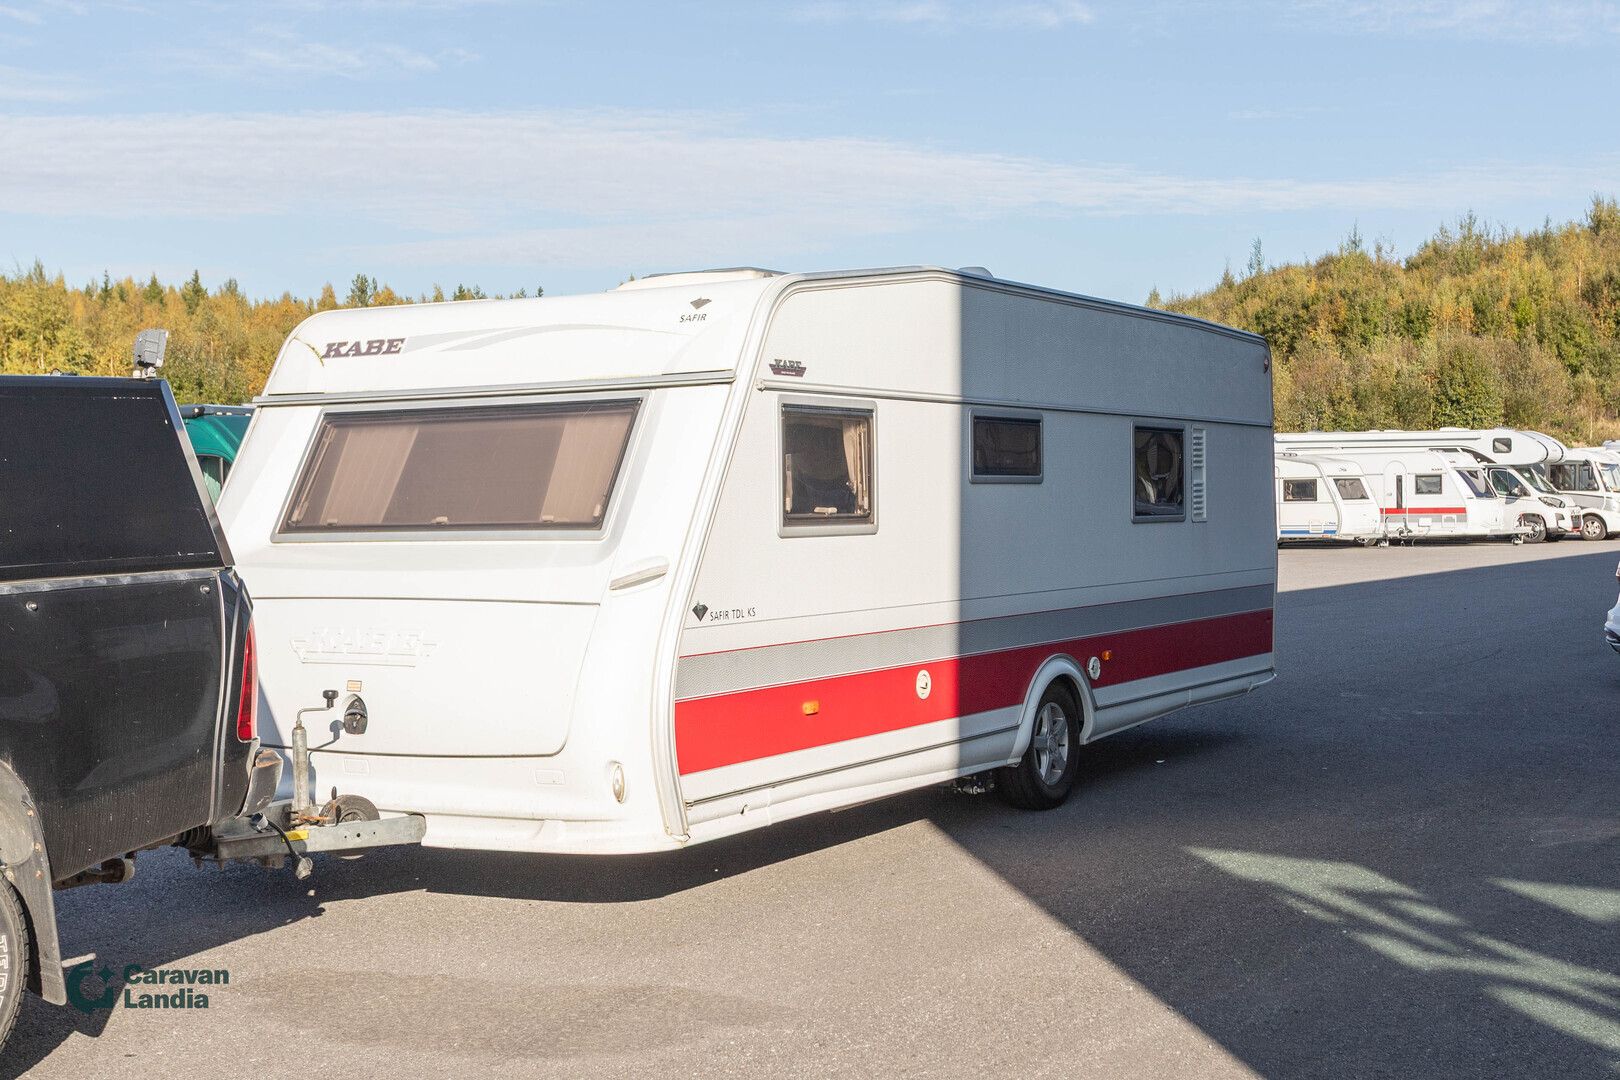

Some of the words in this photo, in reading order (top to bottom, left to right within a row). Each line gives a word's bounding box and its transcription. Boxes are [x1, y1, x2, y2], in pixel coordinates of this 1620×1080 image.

[679, 313, 707, 323] SAFIR
[321, 338, 406, 359] KABE
[774, 359, 802, 370] KABE
[710, 610, 730, 621] SAFIR
[731, 608, 745, 619] TDL
[747, 607, 756, 617] KS
